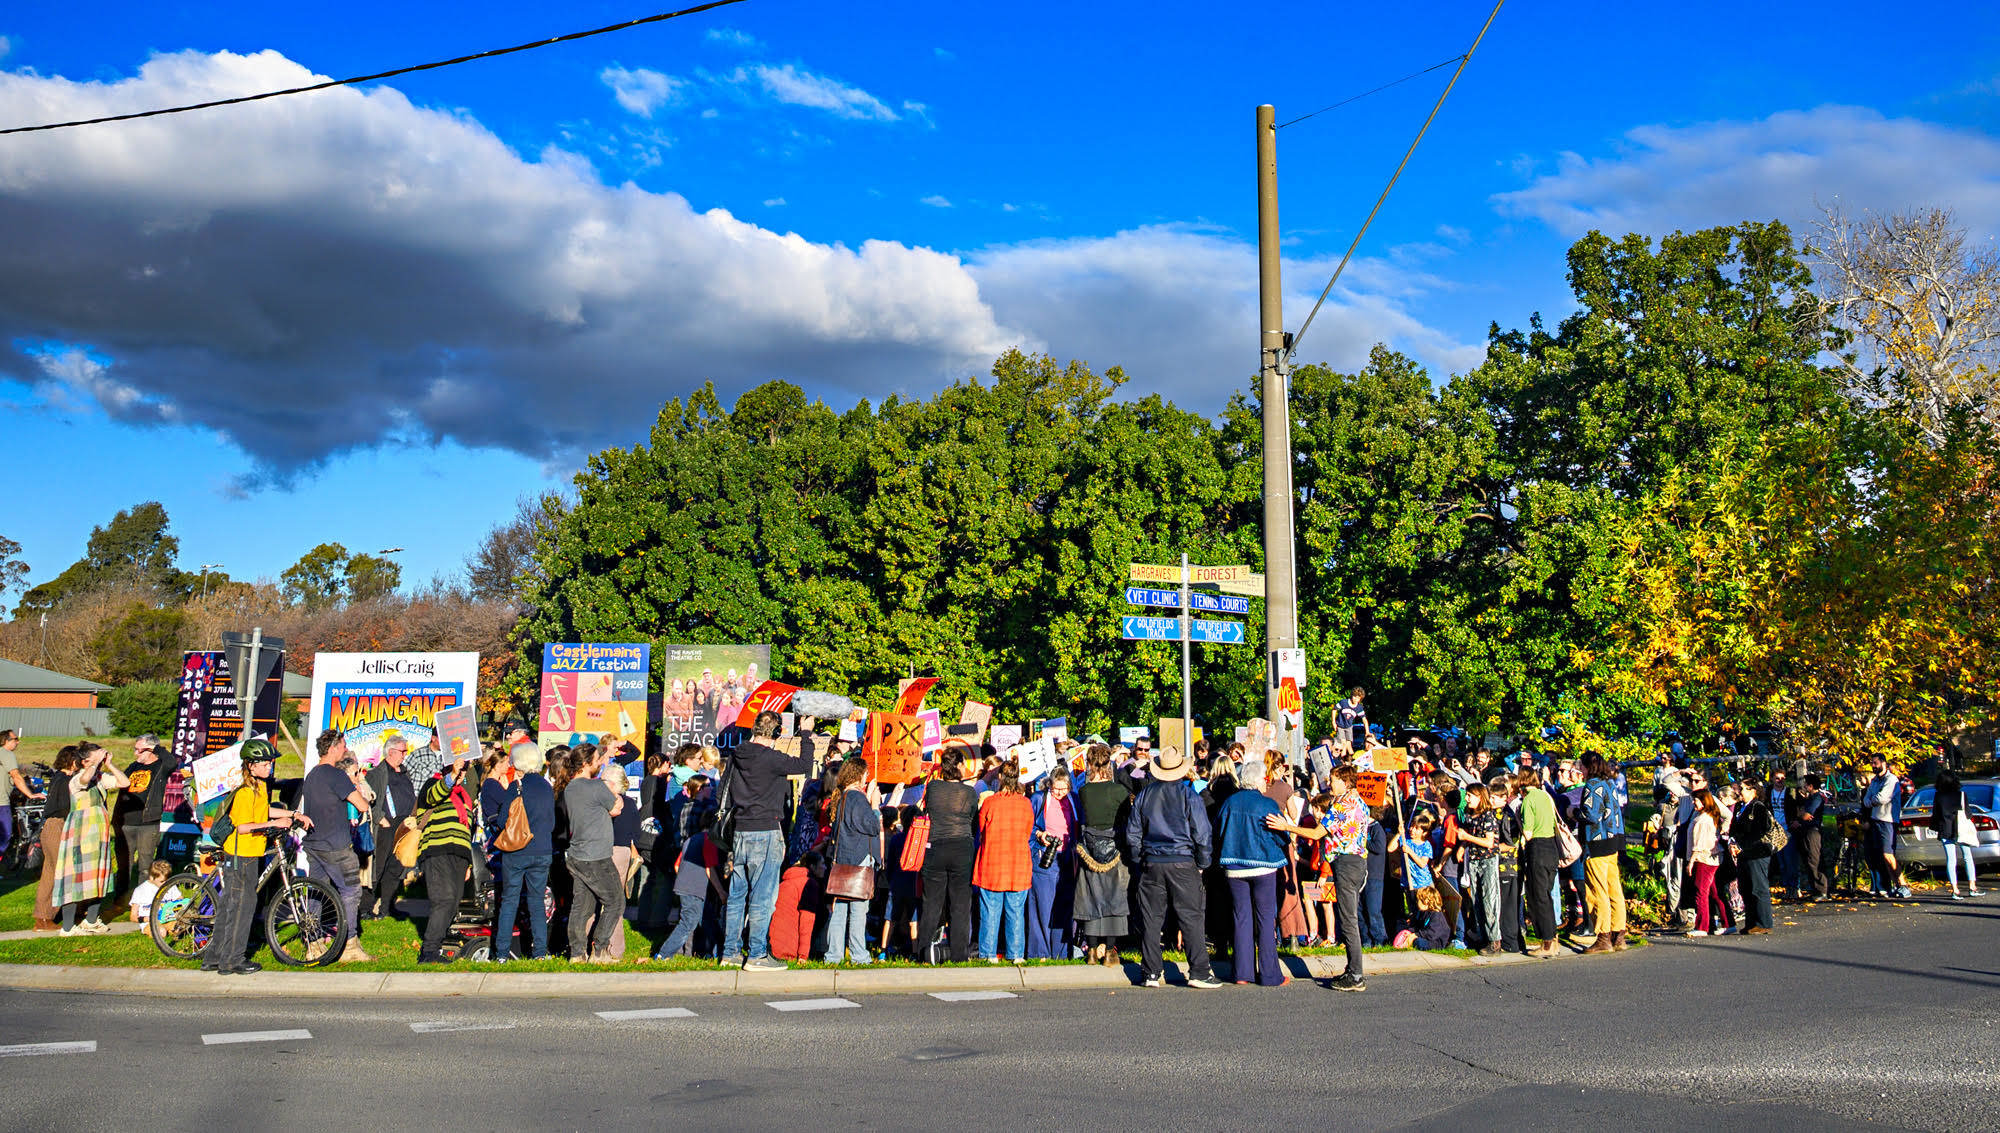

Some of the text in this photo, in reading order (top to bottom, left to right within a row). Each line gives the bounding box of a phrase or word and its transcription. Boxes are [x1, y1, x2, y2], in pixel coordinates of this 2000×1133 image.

[1131, 567, 1171, 580] HARGRAVES
[1197, 568, 1238, 581] FOREST
[1133, 590, 1176, 605] VET CLINIC
[1194, 594, 1248, 611] TENNIS COURTS
[1137, 619, 1174, 630] GOLDFIELDS
[1197, 621, 1231, 632] GOLDFIELDS
[1146, 628, 1166, 639] TRACK
[1205, 630, 1223, 641] TRACK
[551, 644, 642, 660] Castlemaine
[219, 660, 229, 668] Ro
[551, 658, 641, 671] JAZZ Festival
[192, 669, 204, 711] 2026
[615, 680, 644, 690] 2026
[175, 668, 193, 757] ART SHOW
[669, 715, 704, 732] THE
[168, 839, 187, 851] belle
